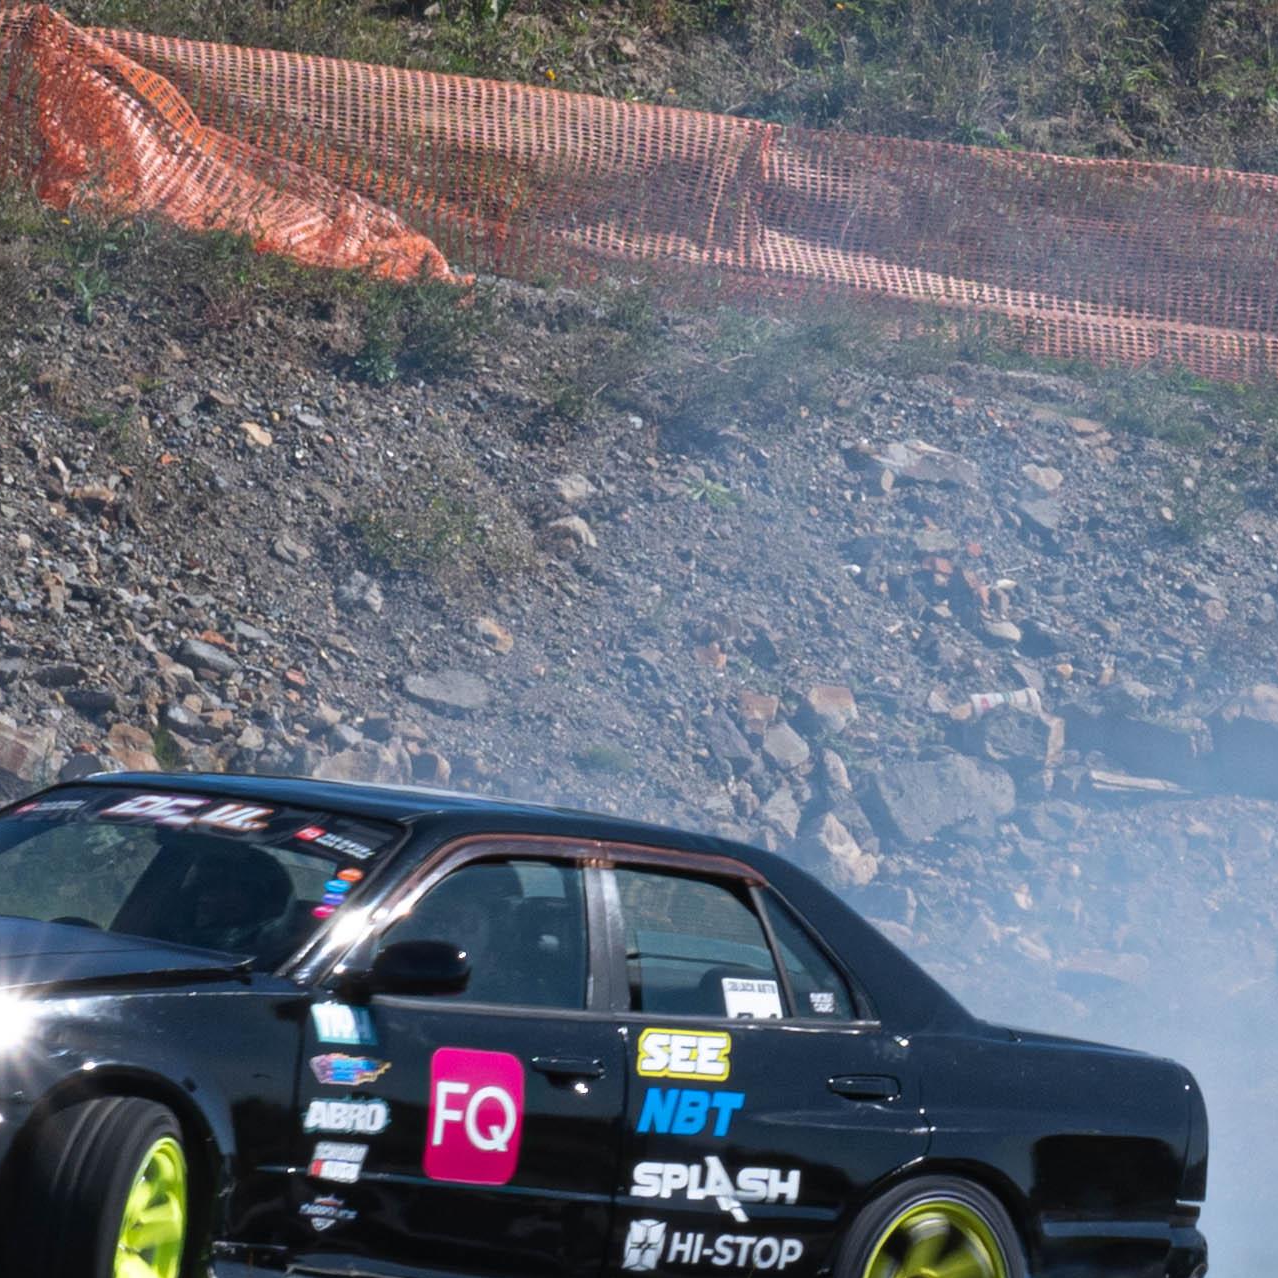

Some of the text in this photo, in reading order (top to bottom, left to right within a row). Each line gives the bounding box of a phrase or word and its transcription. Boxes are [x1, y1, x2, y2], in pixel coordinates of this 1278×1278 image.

[639, 1031, 729, 1077] SEE
[303, 1099, 389, 1134] ABRO
[431, 1080, 518, 1153] FQ
[636, 1087, 746, 1138] NBT
[629, 1155, 802, 1223] SPLASH
[666, 1231, 804, 1271] HI-STOP
